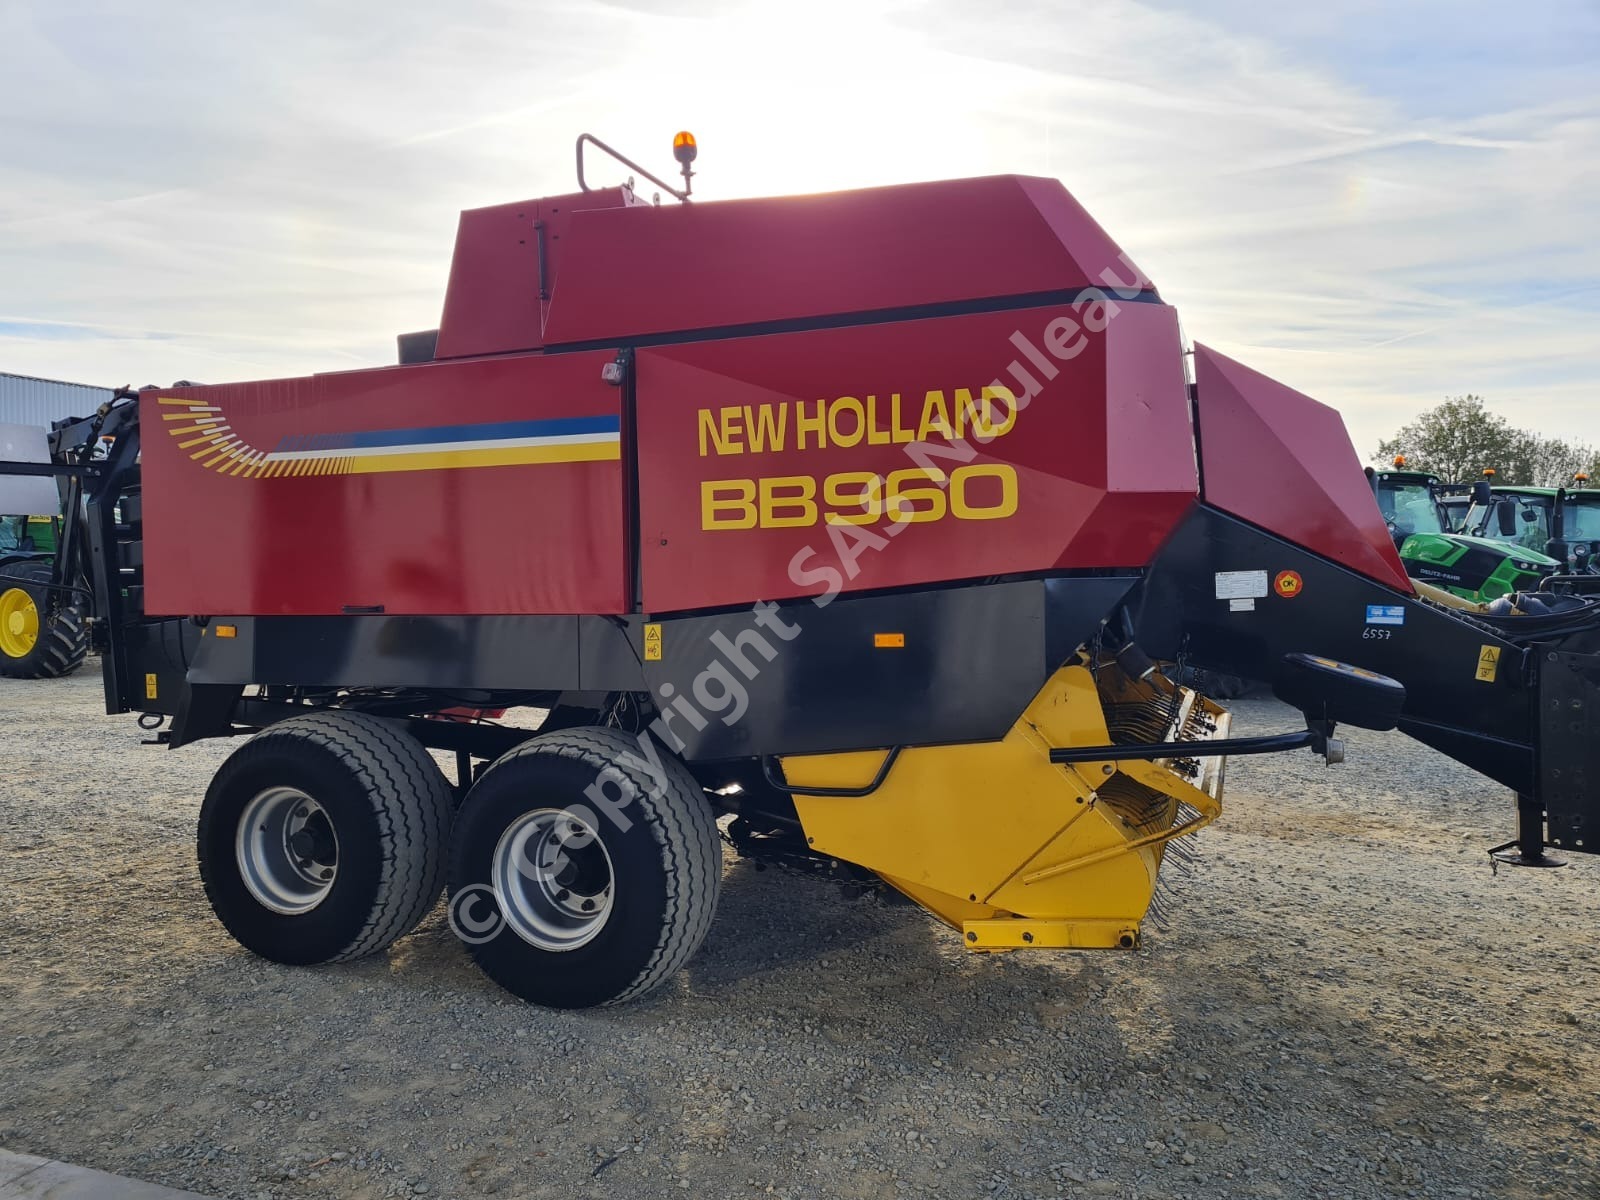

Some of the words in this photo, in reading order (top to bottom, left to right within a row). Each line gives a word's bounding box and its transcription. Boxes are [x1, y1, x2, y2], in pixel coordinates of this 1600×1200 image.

[698, 402, 787, 456] NEW
[797, 386, 1017, 449] HOLLAND
[701, 464, 1018, 530] BB960
[1282, 580, 1294, 588] OK
[1362, 627, 1392, 640] 6557
